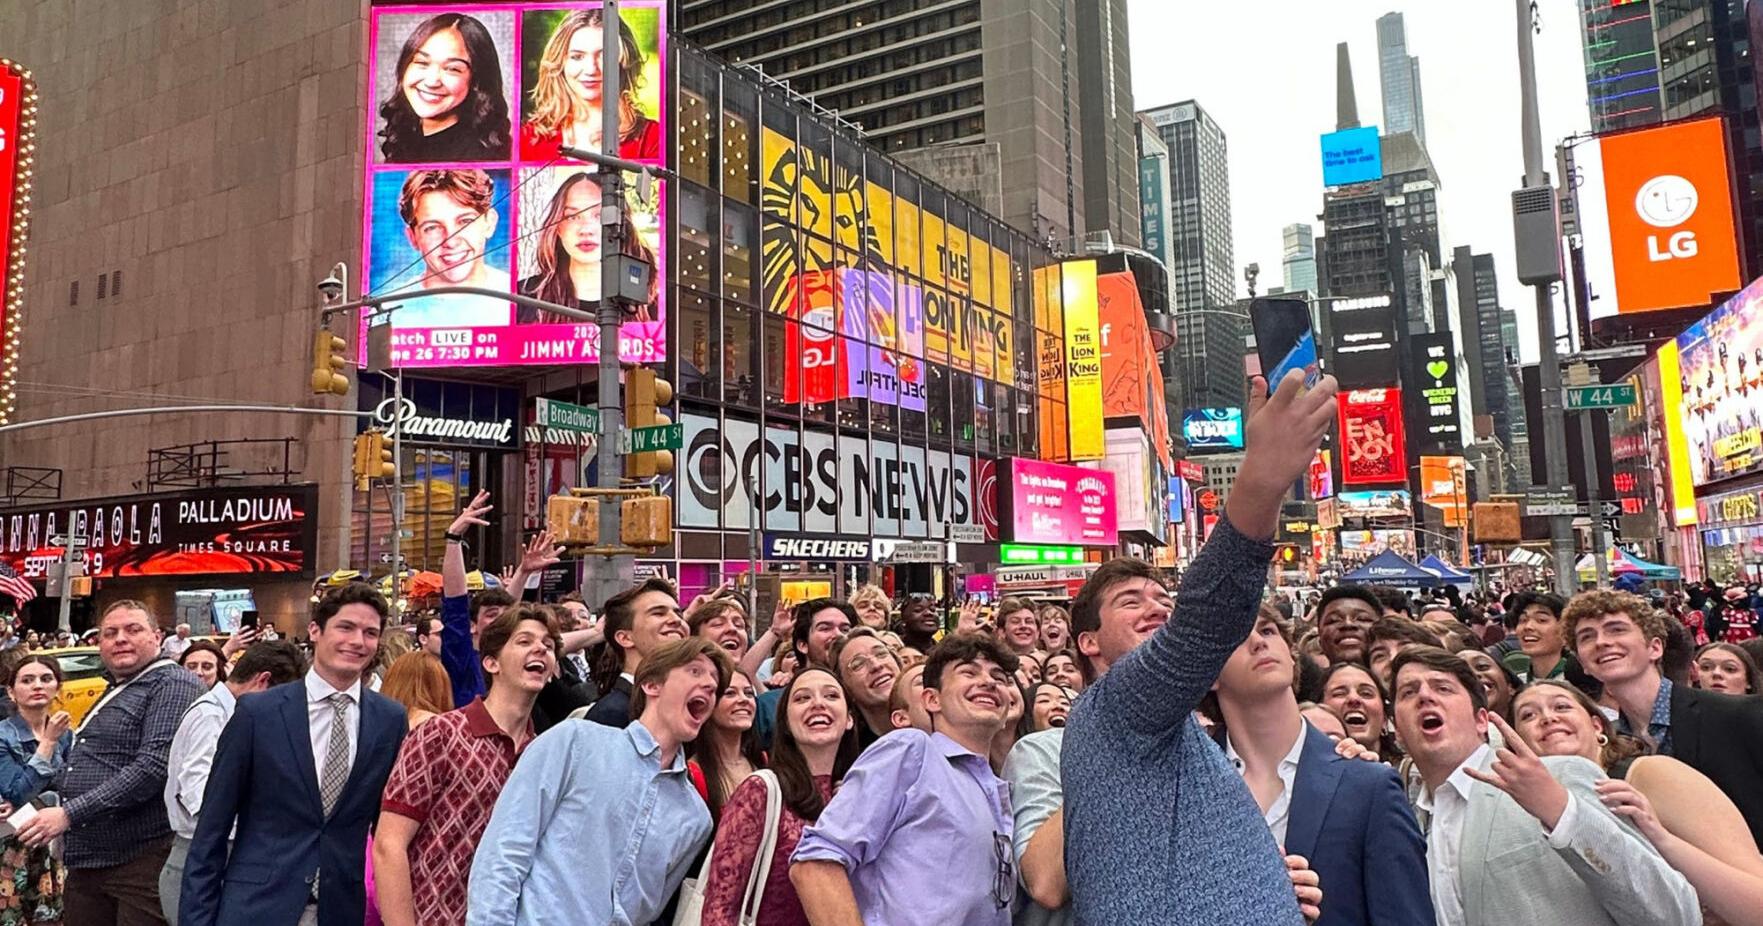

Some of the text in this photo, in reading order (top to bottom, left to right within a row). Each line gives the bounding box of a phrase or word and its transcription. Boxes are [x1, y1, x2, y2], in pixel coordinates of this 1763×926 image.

[1143, 169, 1158, 250] TIMES
[1647, 231, 1698, 262] LG
[937, 244, 969, 283] THE
[903, 265, 1008, 353] LION KING
[1332, 296, 1391, 312] SAMSUNG
[391, 332, 497, 345] atch LIVE on
[520, 337, 654, 359] JIMMY ARDS
[1074, 334, 1091, 343] THE
[391, 346, 498, 361] ne 26 7:30 PM
[1071, 346, 1095, 360] LION
[1069, 362, 1099, 378] KING
[1569, 390, 1583, 406] W
[1590, 388, 1613, 405] 44
[376, 398, 512, 442] Paramount
[551, 404, 597, 432] Broadway
[1430, 404, 1452, 416] NYC
[634, 431, 645, 449] W
[651, 428, 667, 447] 44
[742, 438, 969, 525] CBS NEWS
[179, 498, 293, 523] PALLADIUM
[76, 503, 162, 548] PAOLA
[179, 540, 290, 554] TIMES SQUARE
[772, 538, 869, 558] SKECHERS
[93, 553, 103, 575] 9
[1369, 567, 1406, 576] Lifeway
